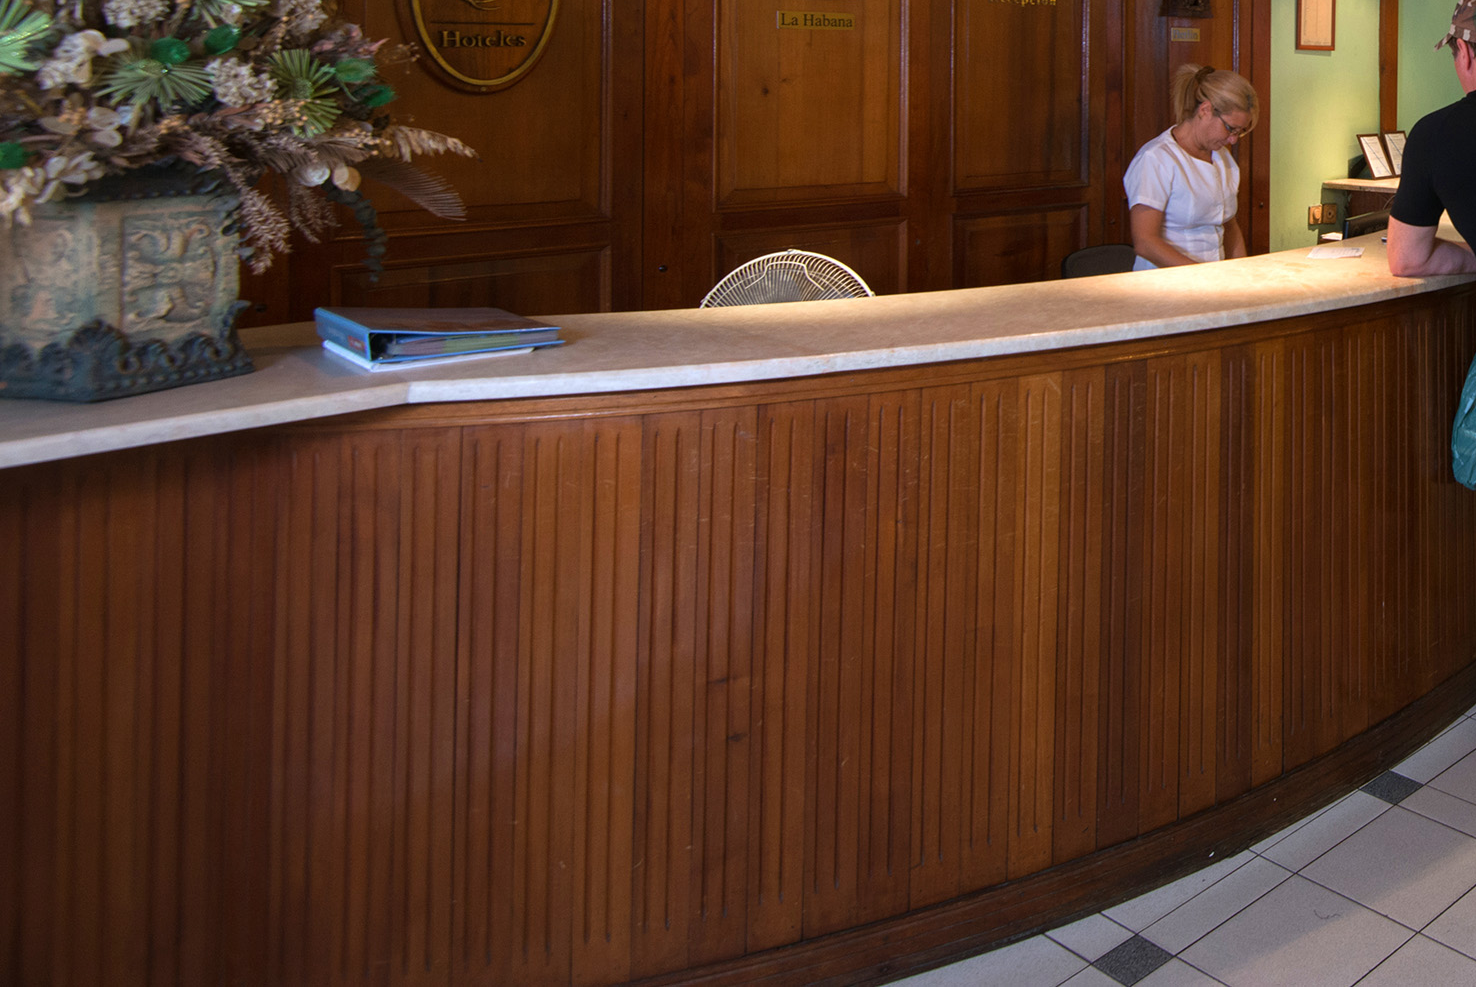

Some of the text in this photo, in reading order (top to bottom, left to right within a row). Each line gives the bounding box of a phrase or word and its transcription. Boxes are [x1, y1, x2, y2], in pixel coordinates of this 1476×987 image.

[780, 12, 853, 28] La Habana
[439, 29, 527, 47] Hoteles
